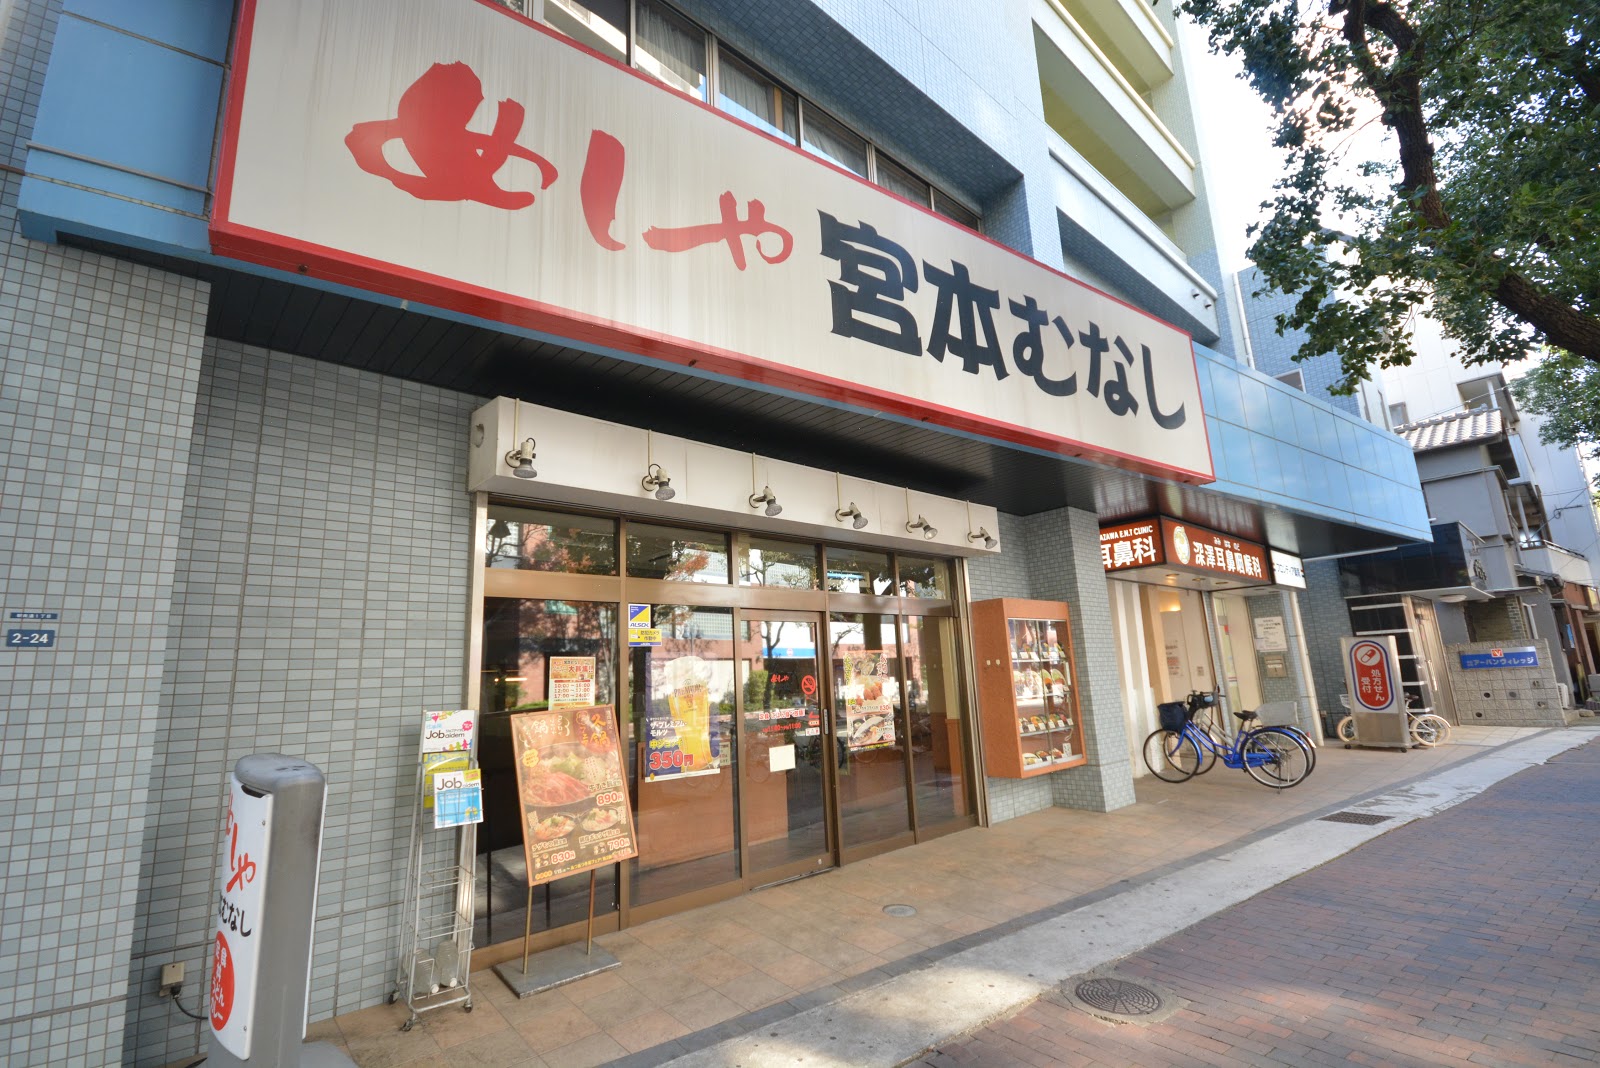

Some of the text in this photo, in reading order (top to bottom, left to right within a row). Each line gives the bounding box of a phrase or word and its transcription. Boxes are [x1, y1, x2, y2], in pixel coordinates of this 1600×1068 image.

[344, 60, 1186, 430] めしや 宮本むなし
[1133, 525, 1154, 536] CLINIC
[11, 633, 48, 644] 2-24
[1361, 677, 1371, 694] 受付
[1371, 669, 1385, 701] 処方せん
[425, 730, 445, 740] Job
[650, 729, 668, 738] モルツ
[649, 750, 695, 770] 350円
[436, 777, 463, 791] Job
[597, 791, 624, 811] 890円
[606, 837, 631, 851] 790円
[550, 850, 576, 865] 830円
